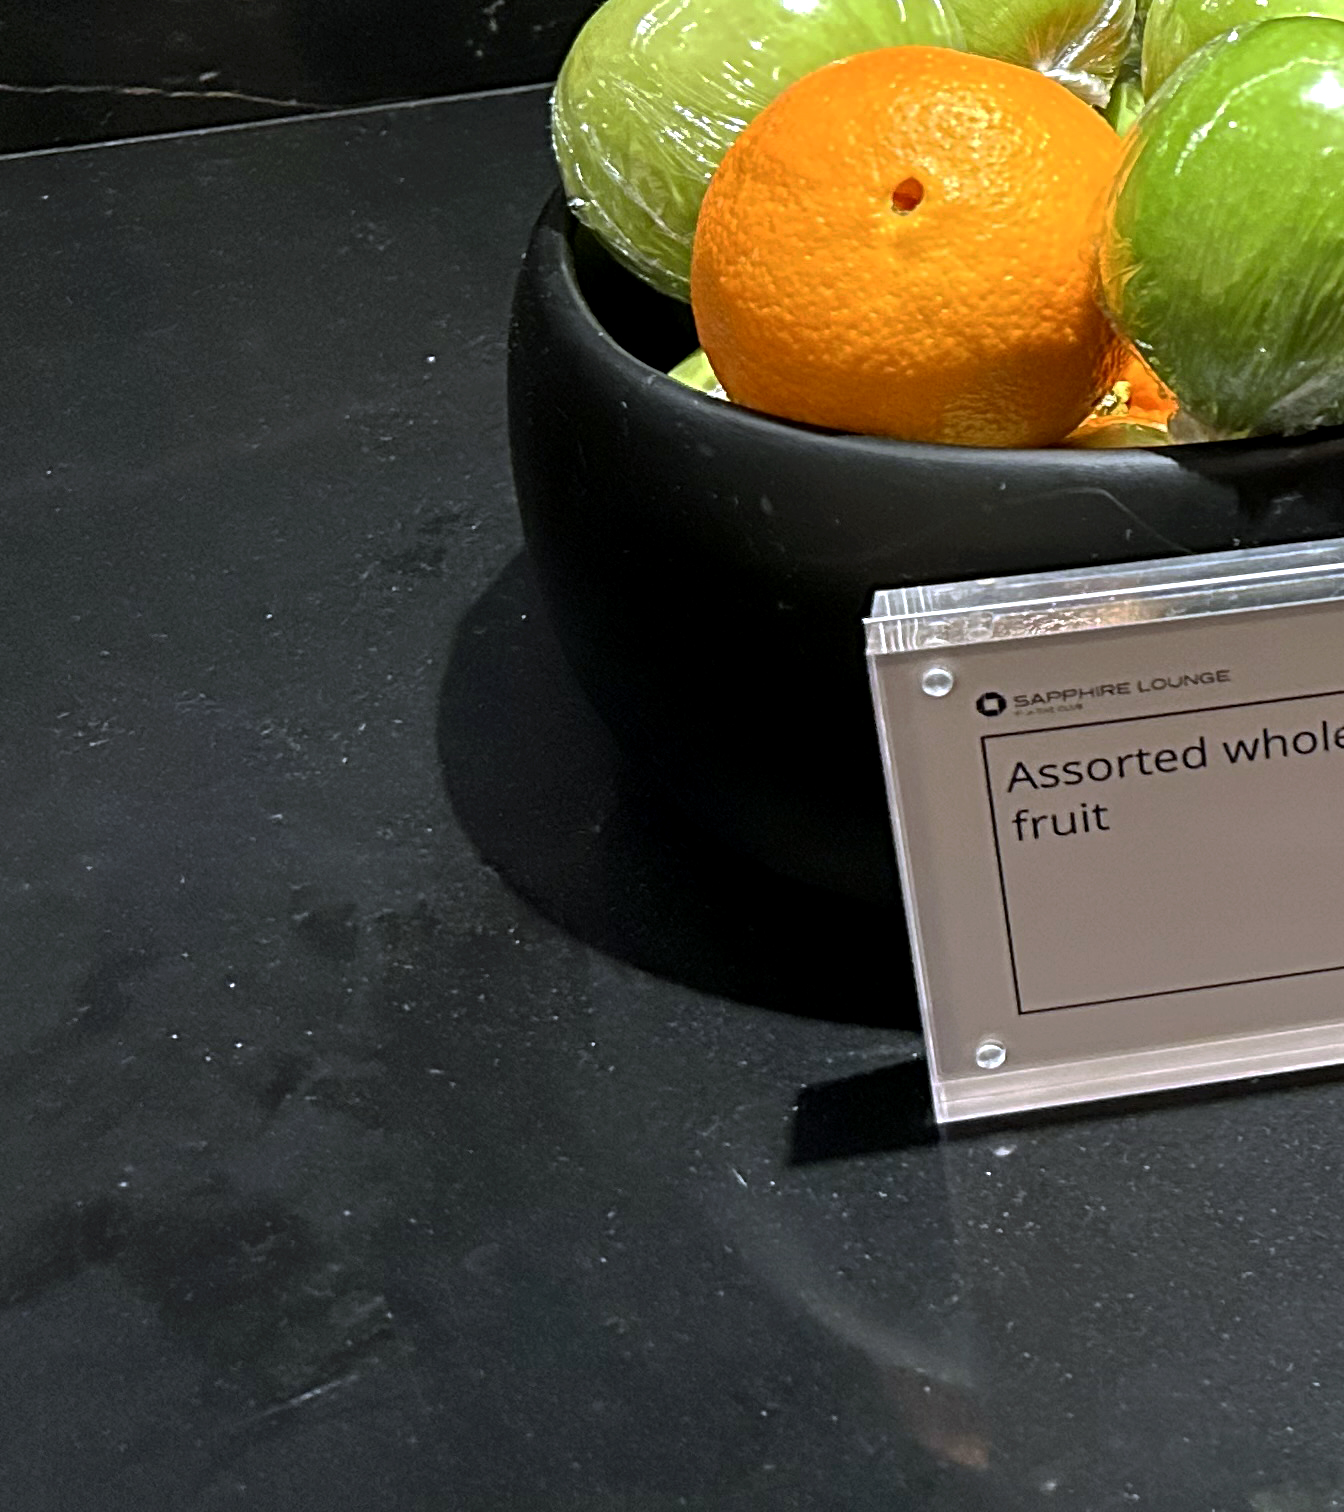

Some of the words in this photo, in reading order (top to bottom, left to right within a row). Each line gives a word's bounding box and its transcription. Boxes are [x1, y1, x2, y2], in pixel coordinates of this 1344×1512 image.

[1012, 681, 1131, 708] SAPPHIRE
[1136, 669, 1232, 693] LOUNGE
[1006, 736, 1208, 793] Assorted
[1011, 802, 1111, 842] fruit
